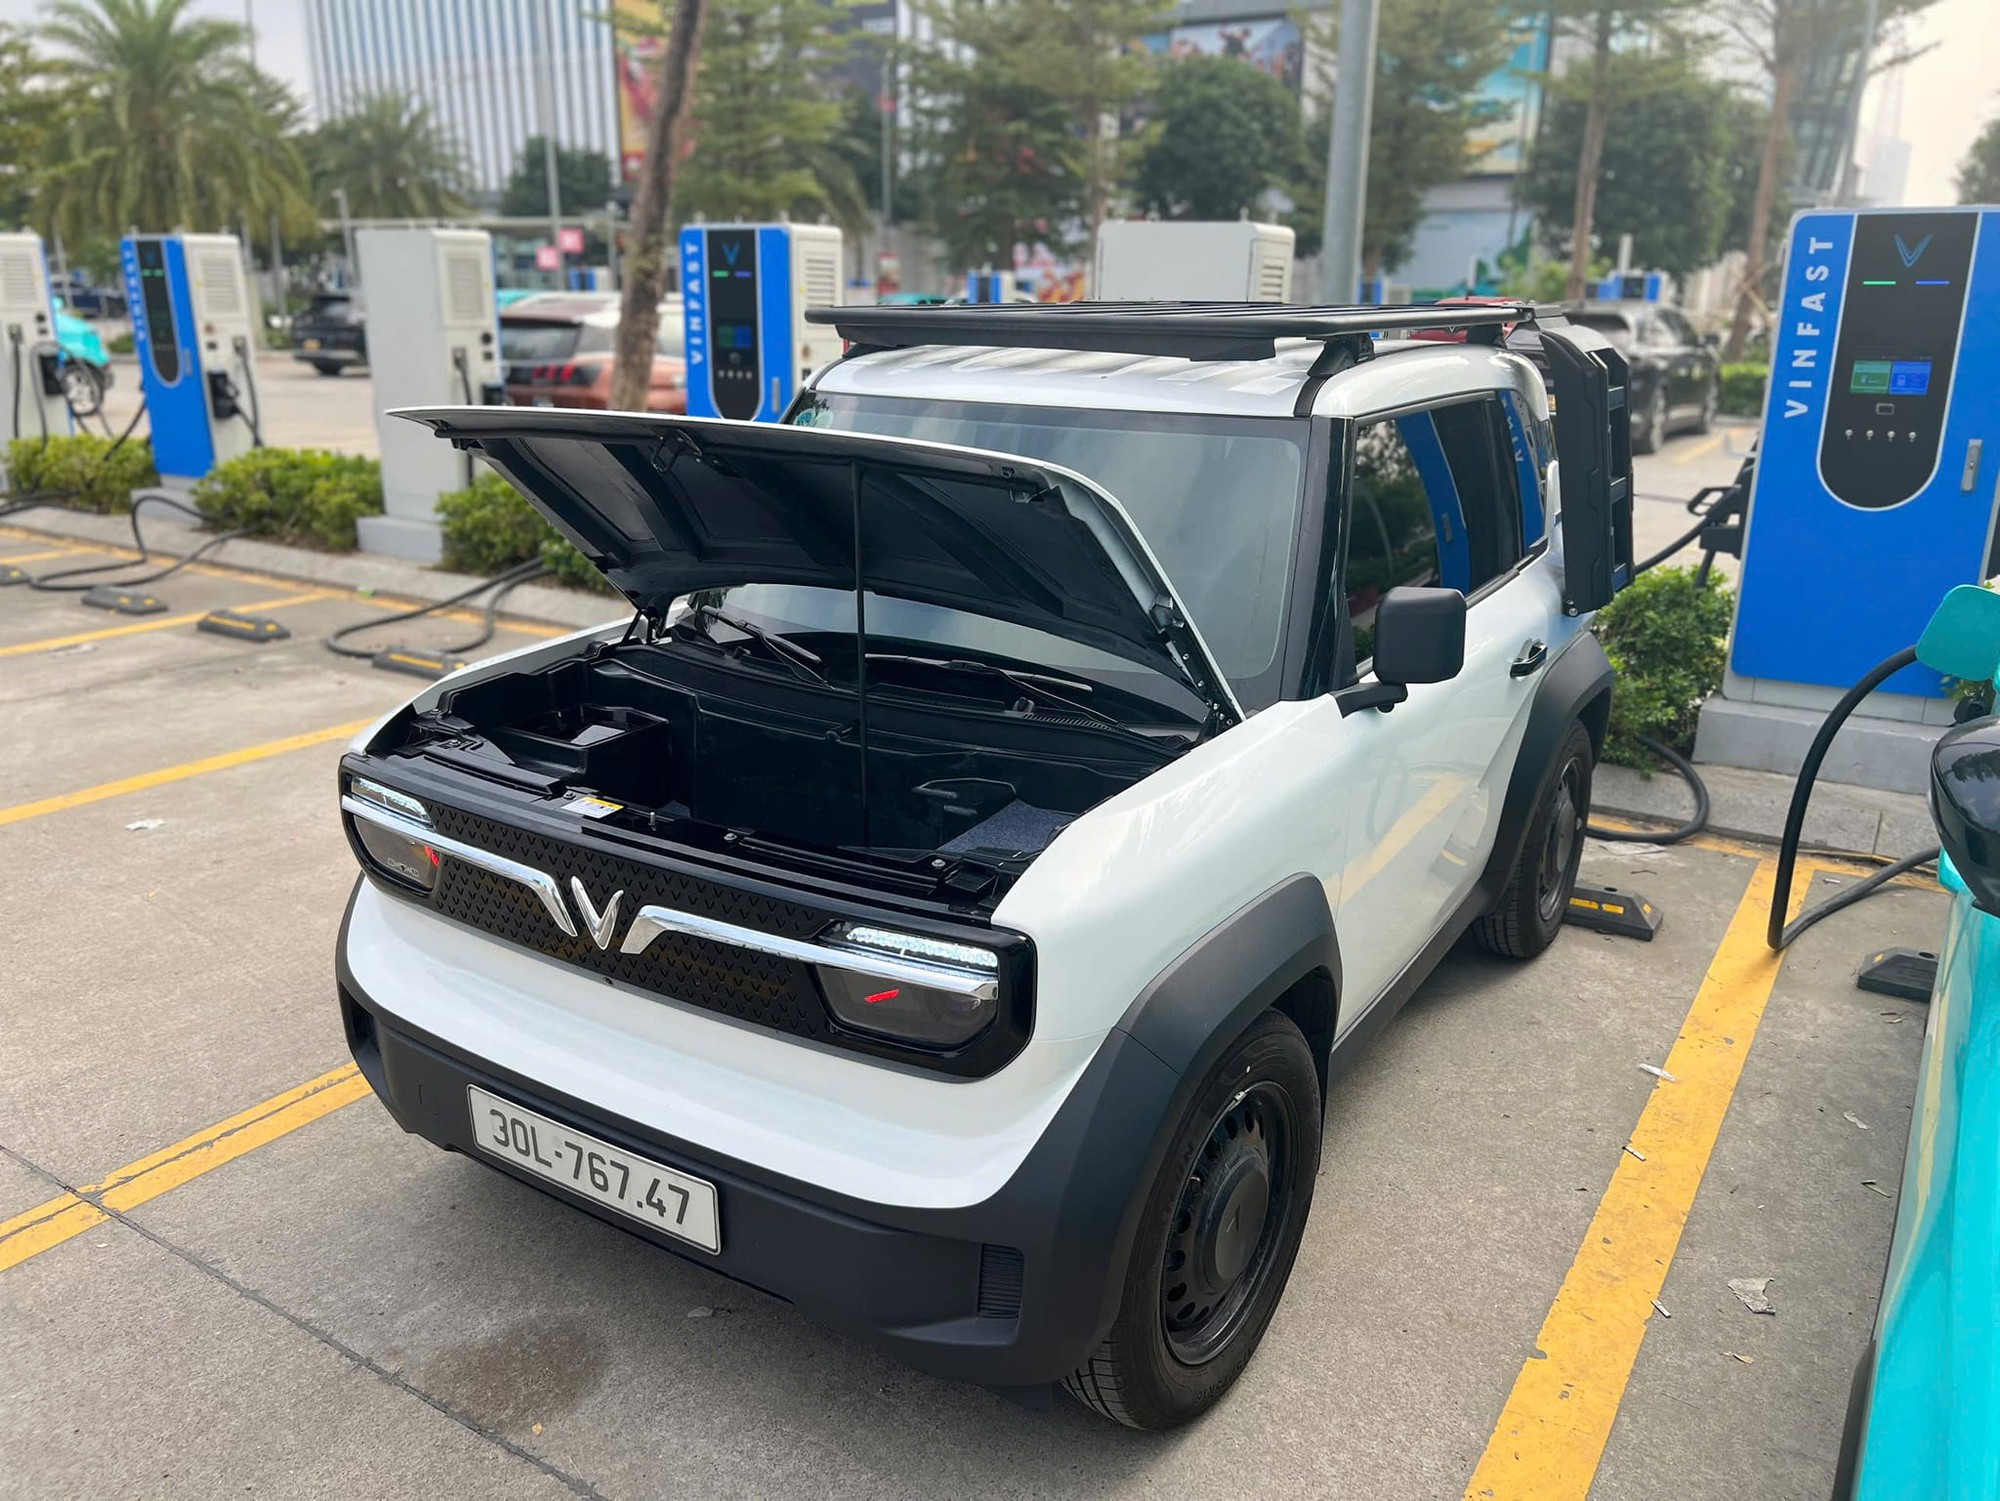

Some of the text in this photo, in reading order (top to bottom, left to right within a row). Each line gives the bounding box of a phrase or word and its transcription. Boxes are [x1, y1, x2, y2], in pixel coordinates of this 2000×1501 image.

[685, 241, 704, 365] VINFAST
[1783, 237, 1833, 420] VINFAST
[490, 1109, 690, 1225] 30L-767.47
